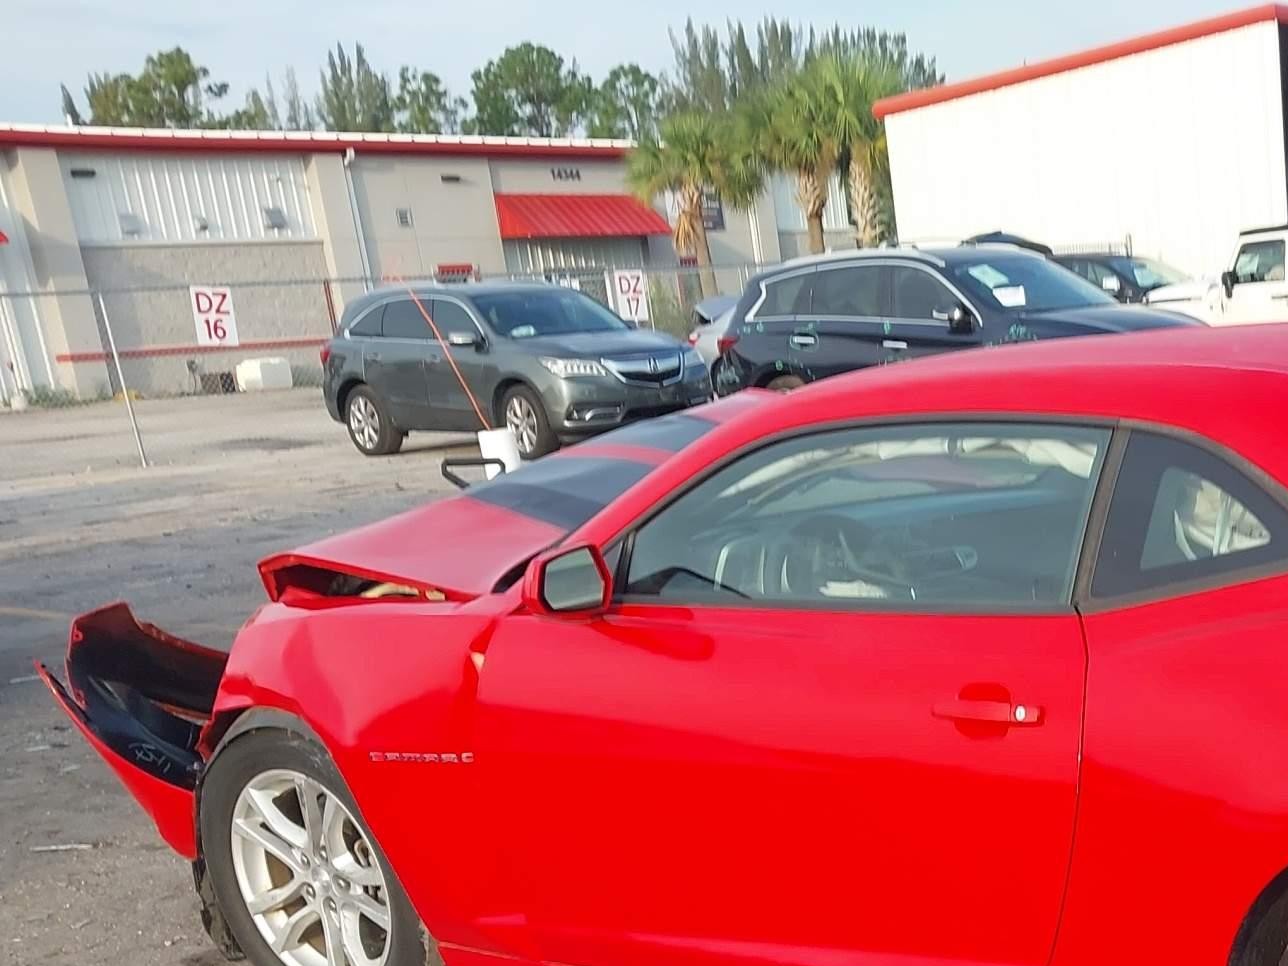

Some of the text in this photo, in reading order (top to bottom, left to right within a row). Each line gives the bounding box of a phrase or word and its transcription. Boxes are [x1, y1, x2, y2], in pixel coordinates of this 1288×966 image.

[619, 274, 642, 294] DZ
[195, 292, 230, 315] DZ
[627, 296, 640, 316] 17
[204, 318, 227, 340] 16
